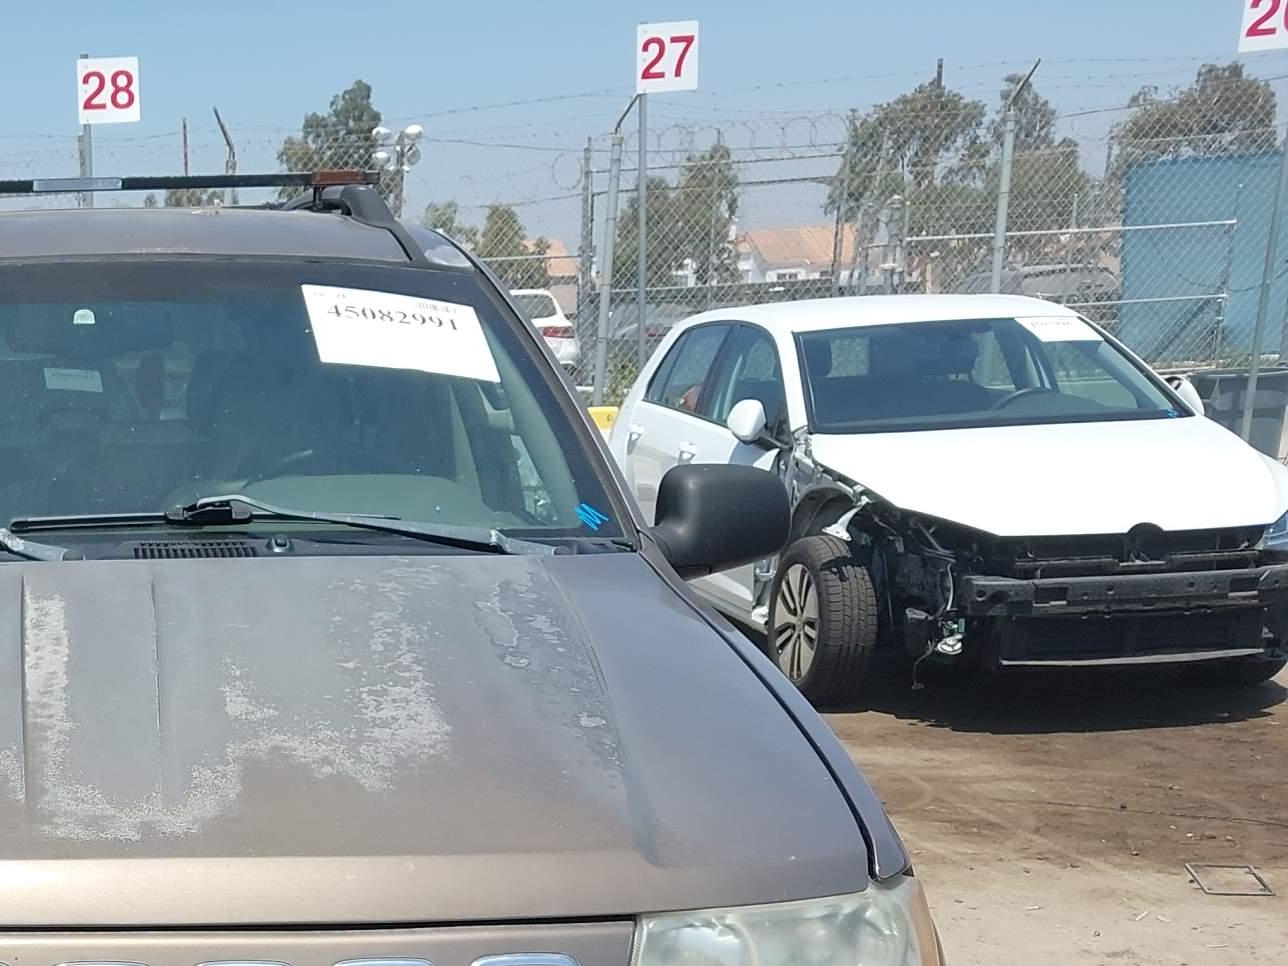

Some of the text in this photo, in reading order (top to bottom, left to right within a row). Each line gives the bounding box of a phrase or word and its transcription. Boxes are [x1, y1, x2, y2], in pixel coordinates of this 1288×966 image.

[1245, 0, 1288, 37] 2
[641, 35, 695, 80] 27
[82, 70, 136, 110] 28
[327, 304, 458, 331] 45082991
